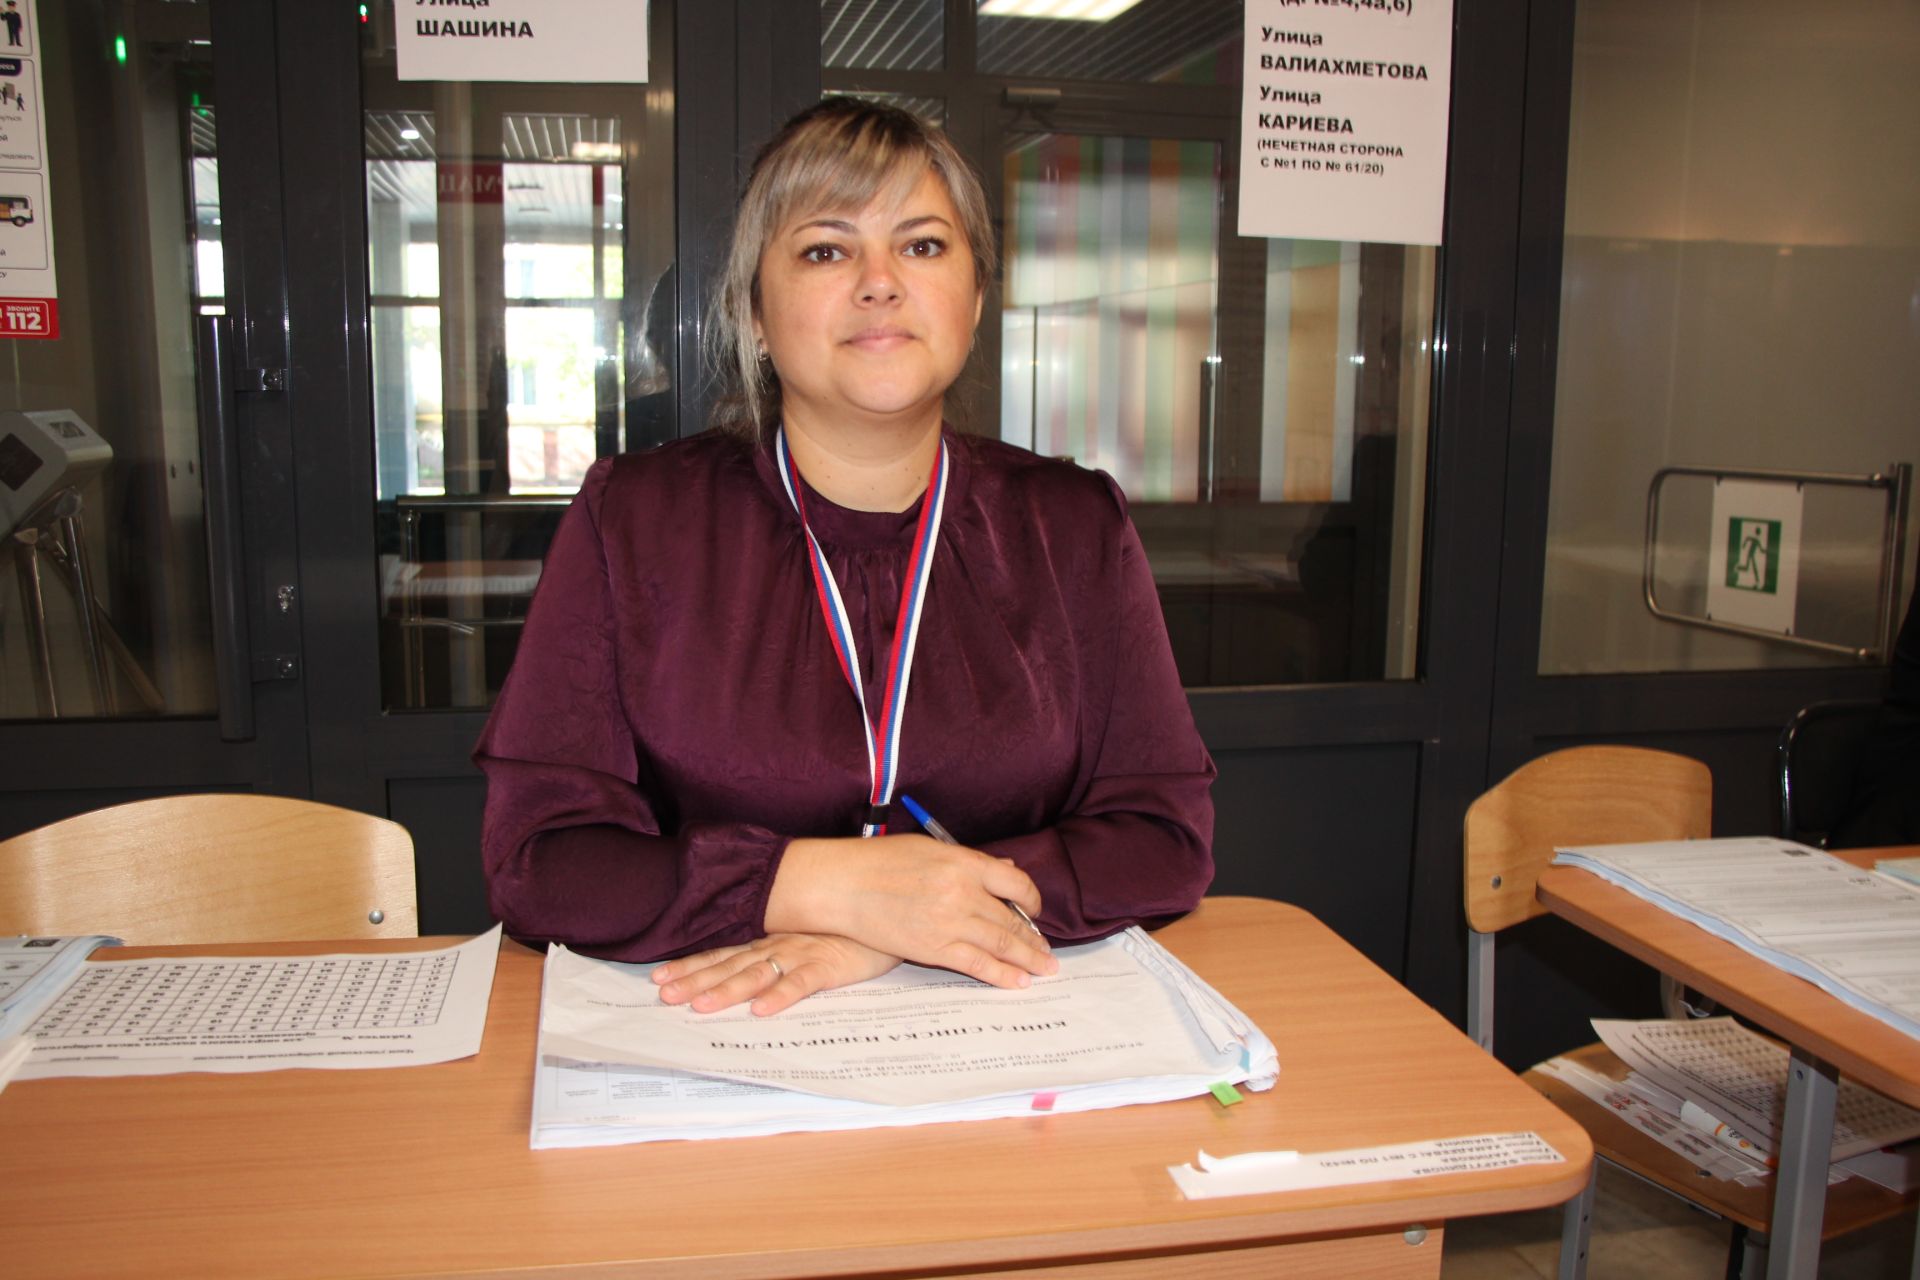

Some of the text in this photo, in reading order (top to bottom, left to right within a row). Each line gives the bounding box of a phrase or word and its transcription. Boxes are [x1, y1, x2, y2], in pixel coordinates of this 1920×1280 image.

[416, 20, 534, 38] ШАШИНА
[1261, 26, 1323, 46] Улица
[1260, 54, 1428, 81] ВАЛИАХМЕТОВА
[1259, 85, 1322, 105] Улица
[1258, 113, 1354, 134] КАРИЕВА
[1257, 138, 1404, 158] (НЕЧЕТНАЯ СТОРОНА
[1260, 157, 1384, 176] С №1 ПО № 61/20)
[6, 312, 42, 330] 112
[710, 1022, 1066, 1050] КНИГА СПИСКА ИЗБИРАТЕЛЕЙ
